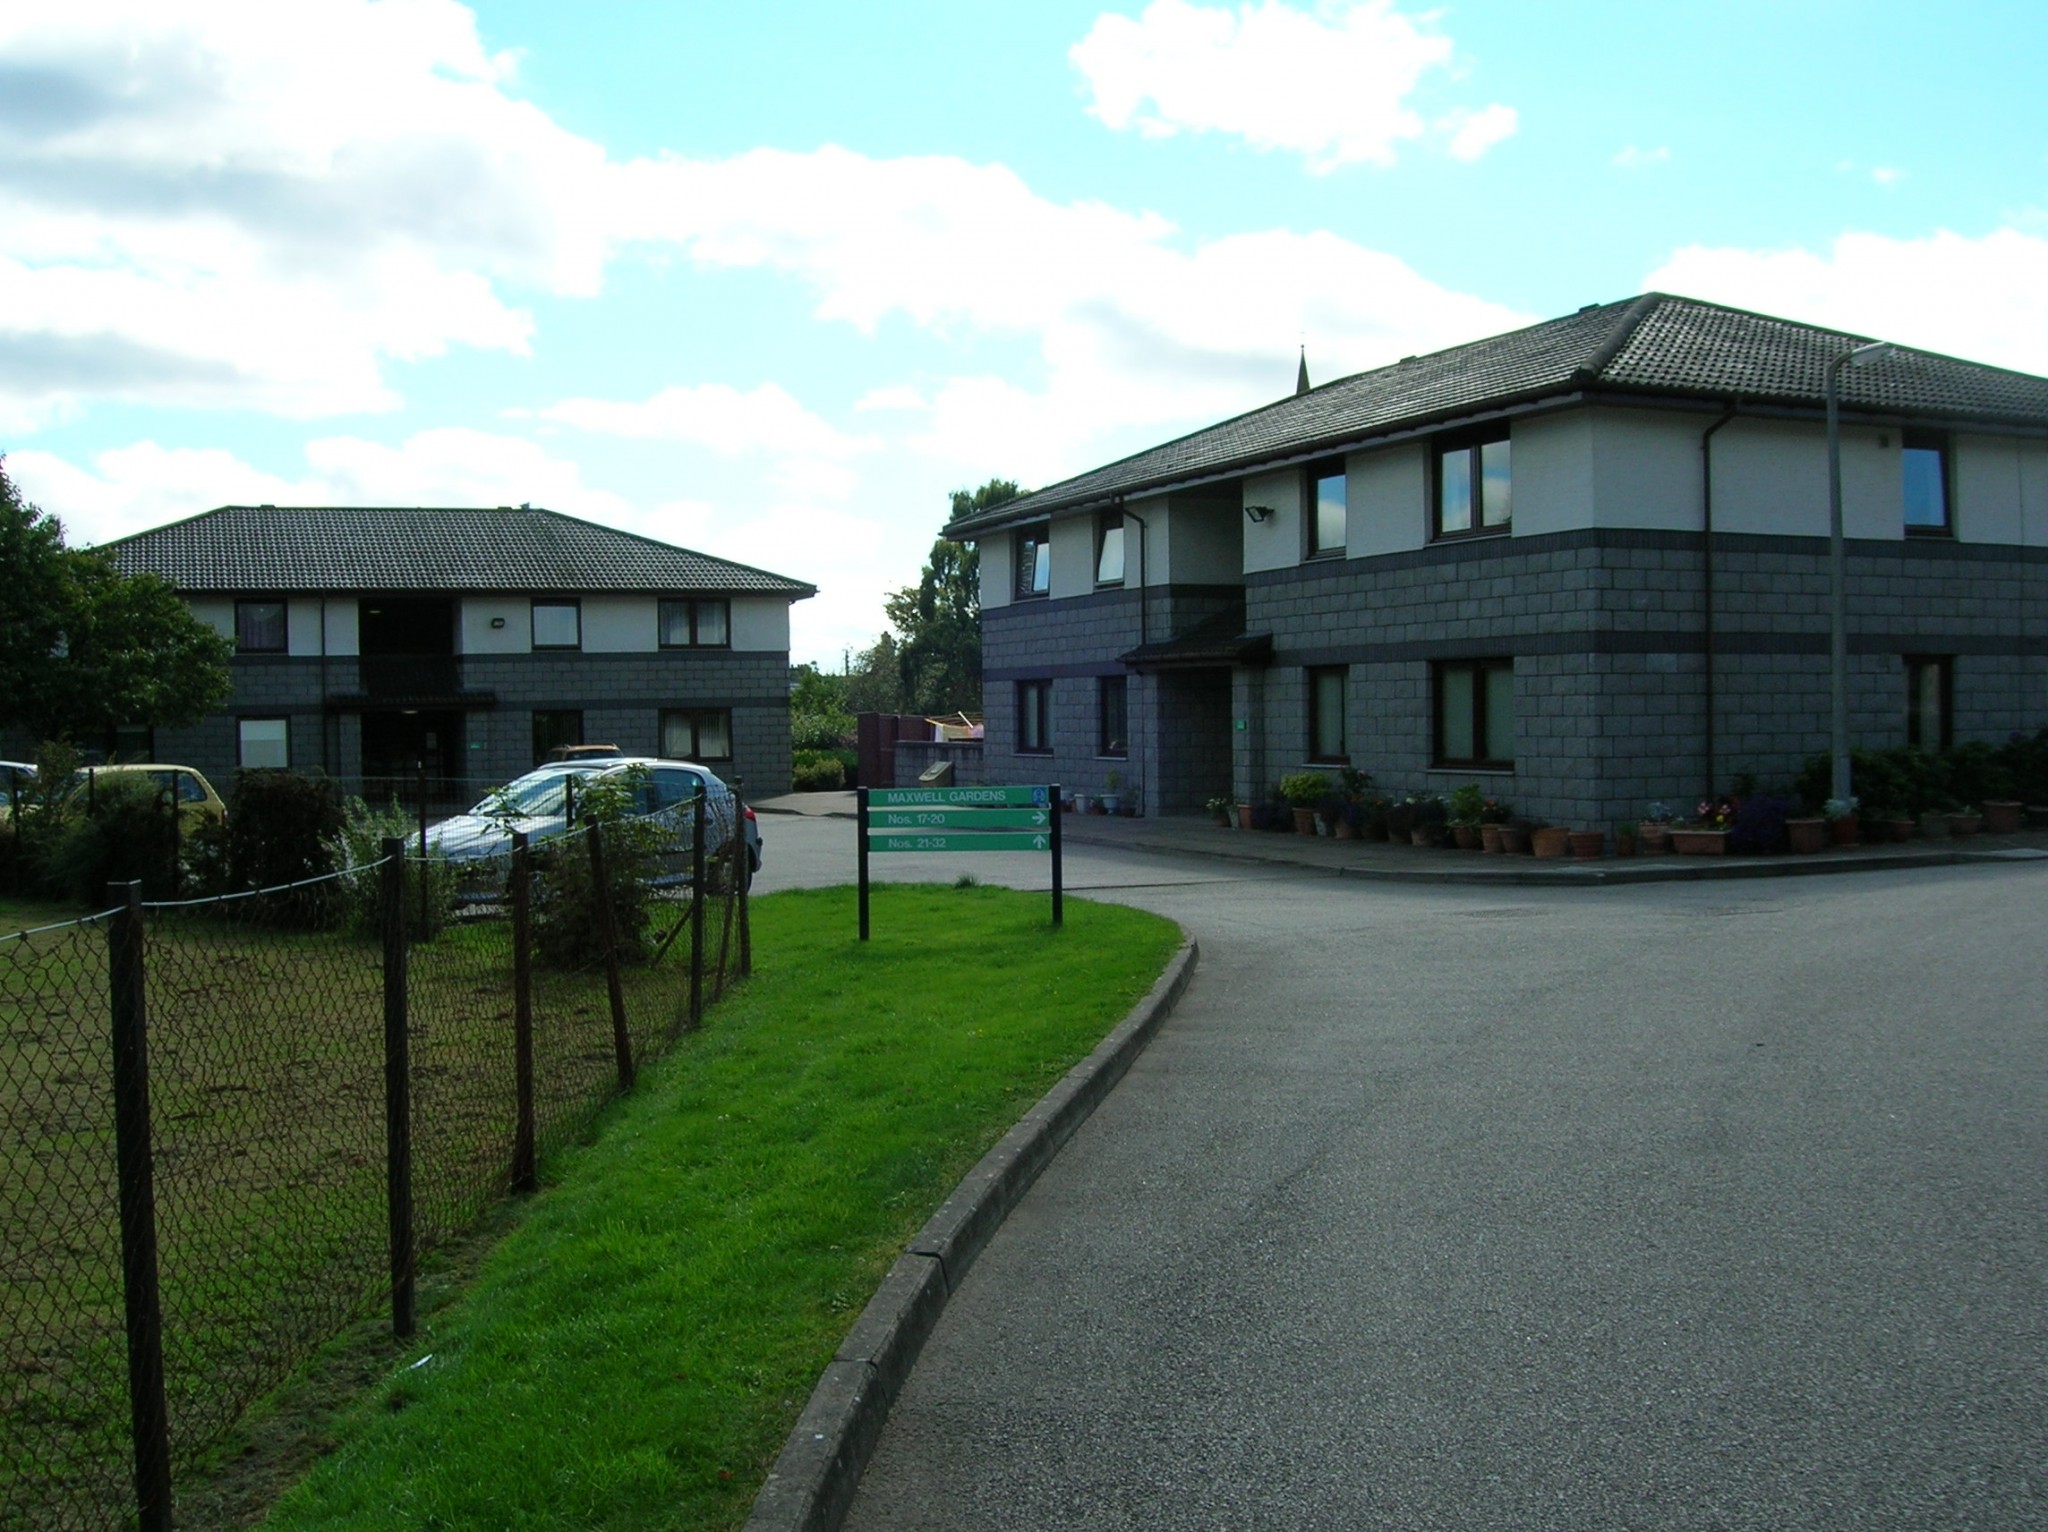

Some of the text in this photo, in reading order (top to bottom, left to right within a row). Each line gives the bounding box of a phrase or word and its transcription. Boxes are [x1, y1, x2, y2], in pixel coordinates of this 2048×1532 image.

[887, 790, 1006, 803] MAXWELL GARDENS
[888, 813, 945, 824] Nos. 17-20
[888, 838, 946, 848] Nos. 21-32
